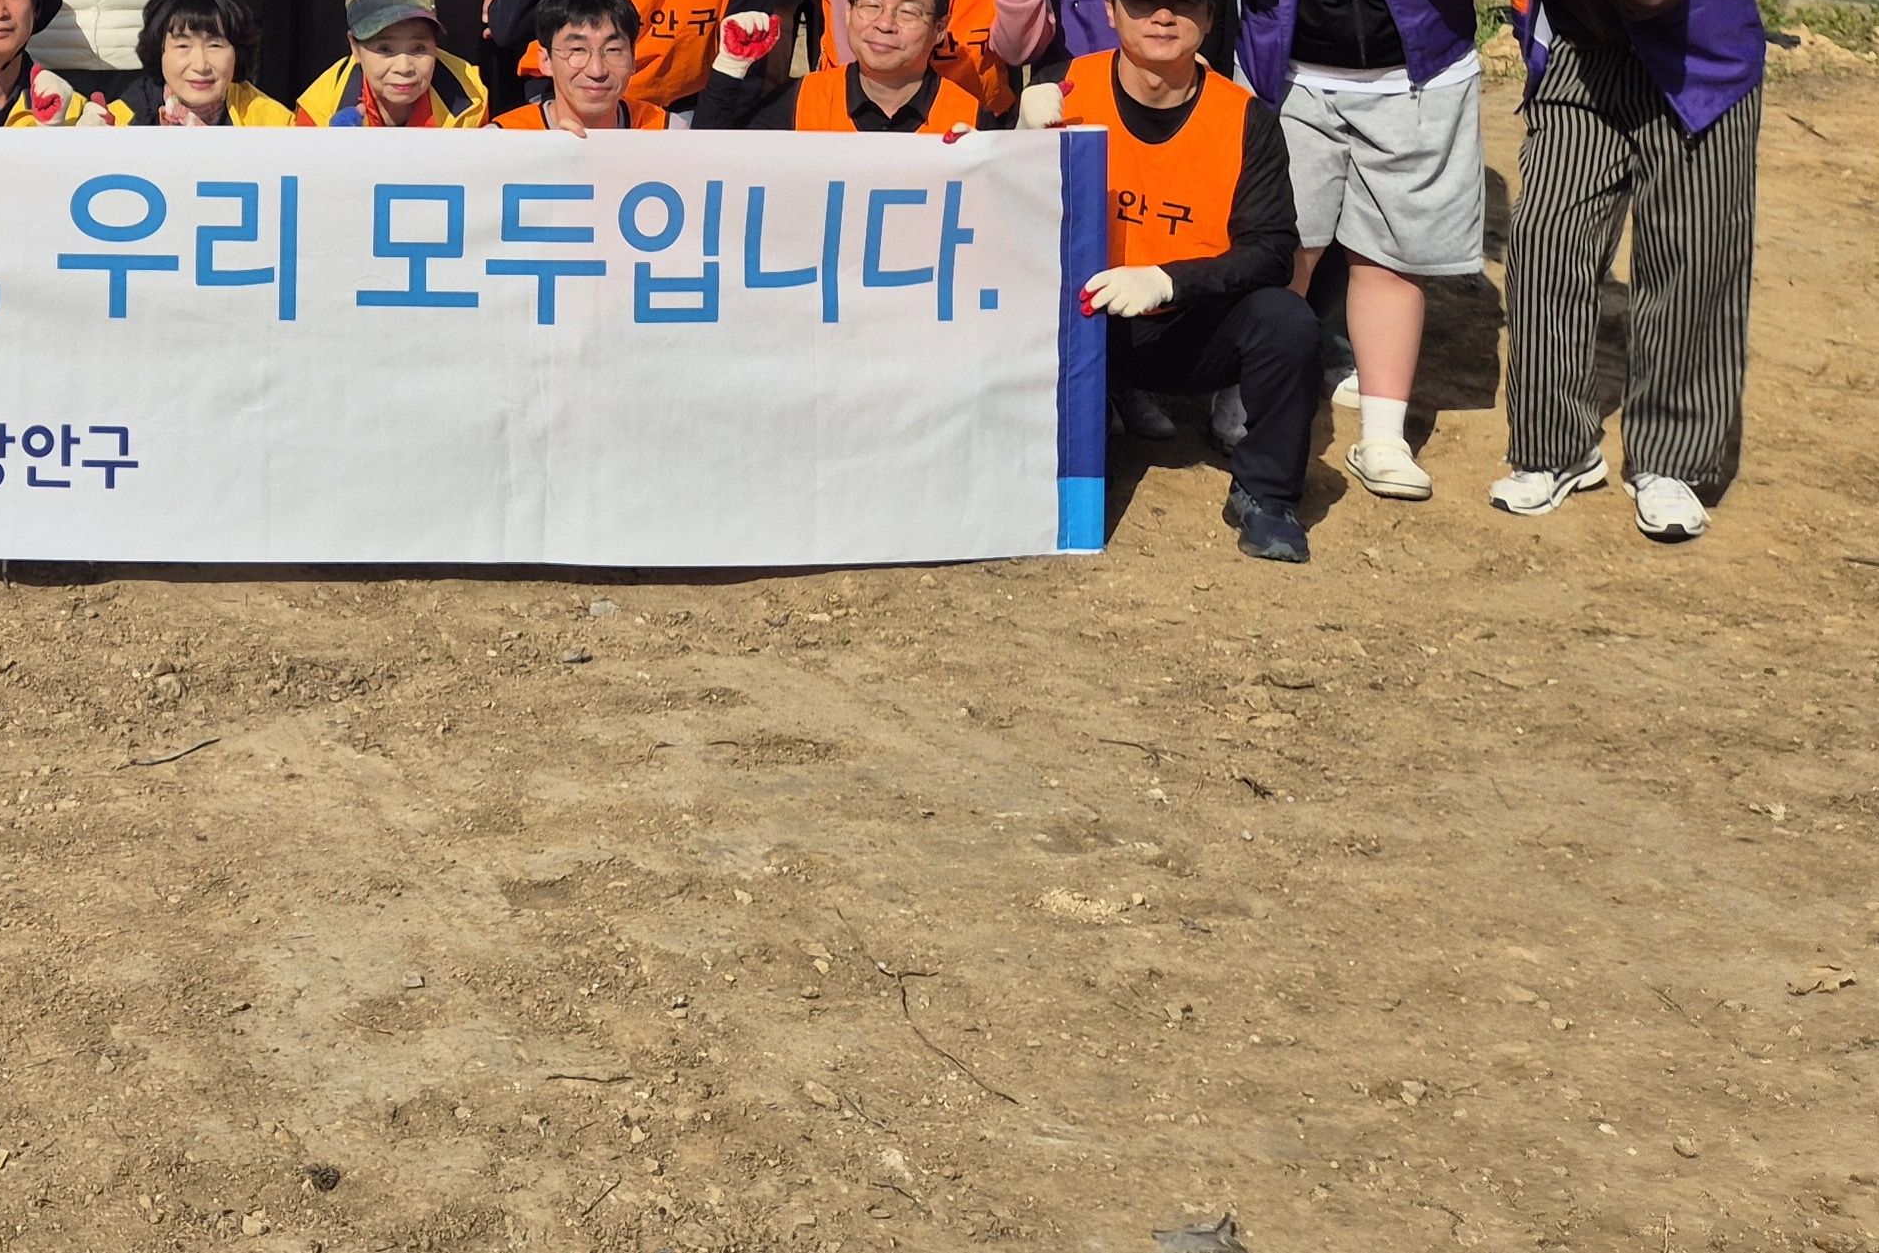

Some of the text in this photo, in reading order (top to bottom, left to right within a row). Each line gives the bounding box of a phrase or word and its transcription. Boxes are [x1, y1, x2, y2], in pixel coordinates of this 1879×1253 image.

[638, 9, 718, 39] 안구
[57, 174, 299, 321] 우리
[355, 180, 1000, 324] 모두입니다.
